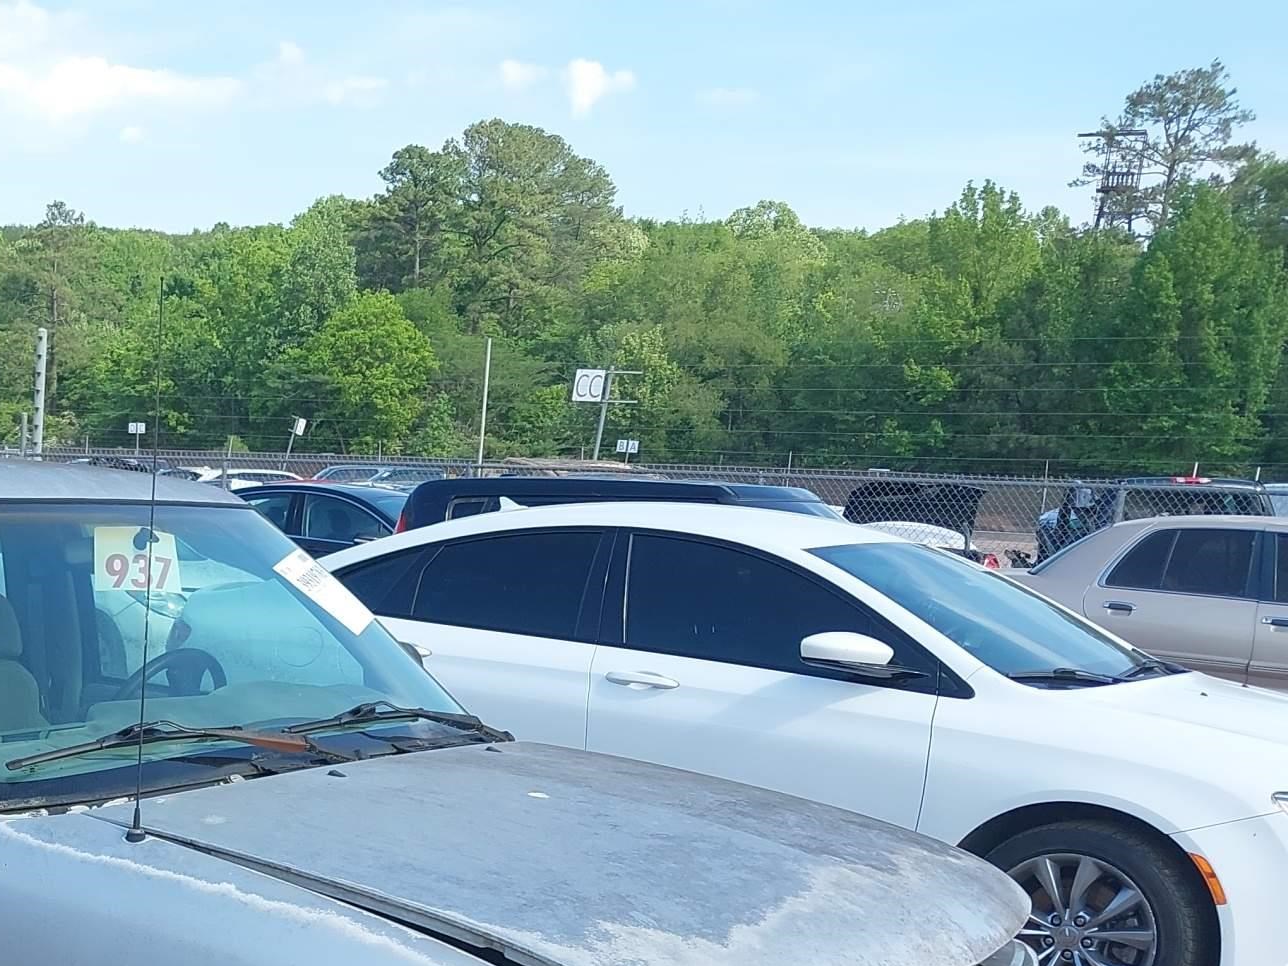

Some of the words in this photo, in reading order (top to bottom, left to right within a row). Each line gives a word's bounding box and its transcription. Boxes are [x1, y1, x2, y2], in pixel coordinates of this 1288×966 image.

[576, 374, 603, 398] CC
[618, 441, 624, 450] B
[630, 442, 637, 451] A
[105, 553, 172, 589] 937
